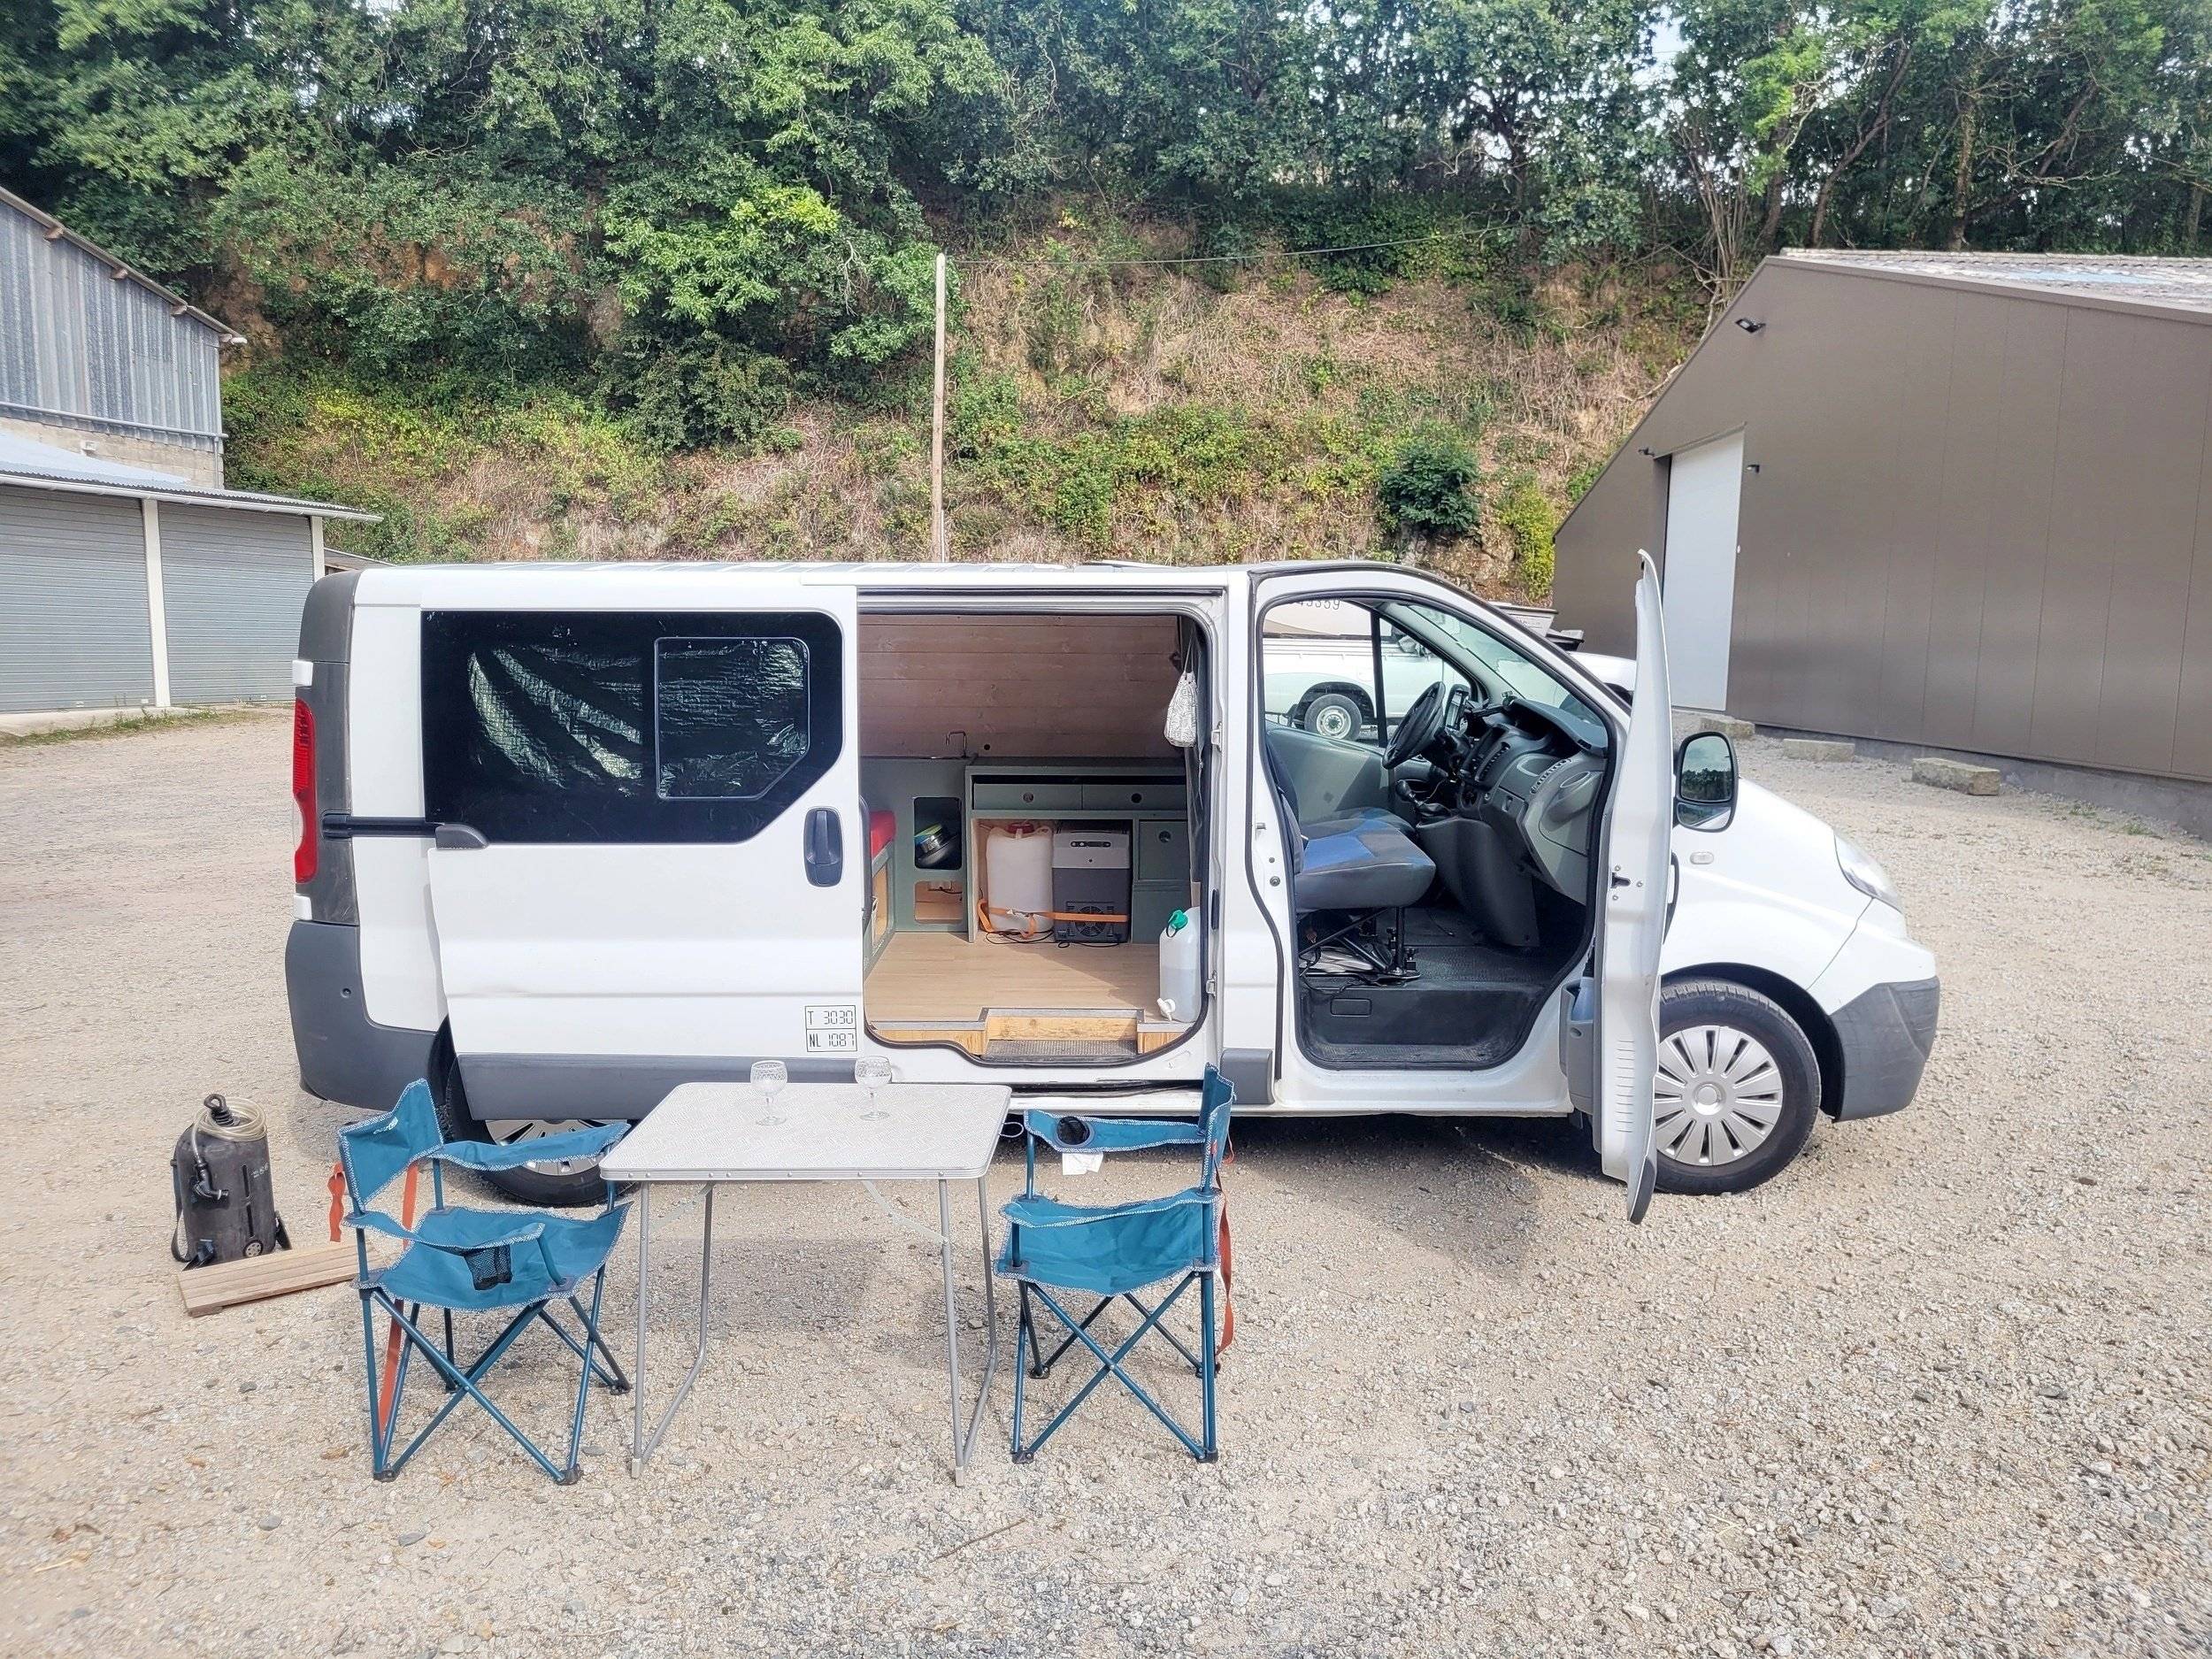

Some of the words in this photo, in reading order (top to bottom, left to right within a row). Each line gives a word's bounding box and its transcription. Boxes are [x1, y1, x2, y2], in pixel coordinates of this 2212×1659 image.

[807, 1010, 814, 1025] T
[823, 1010, 854, 1025] 3030
[809, 1033, 821, 1048] NL
[828, 1033, 855, 1048] 1087
